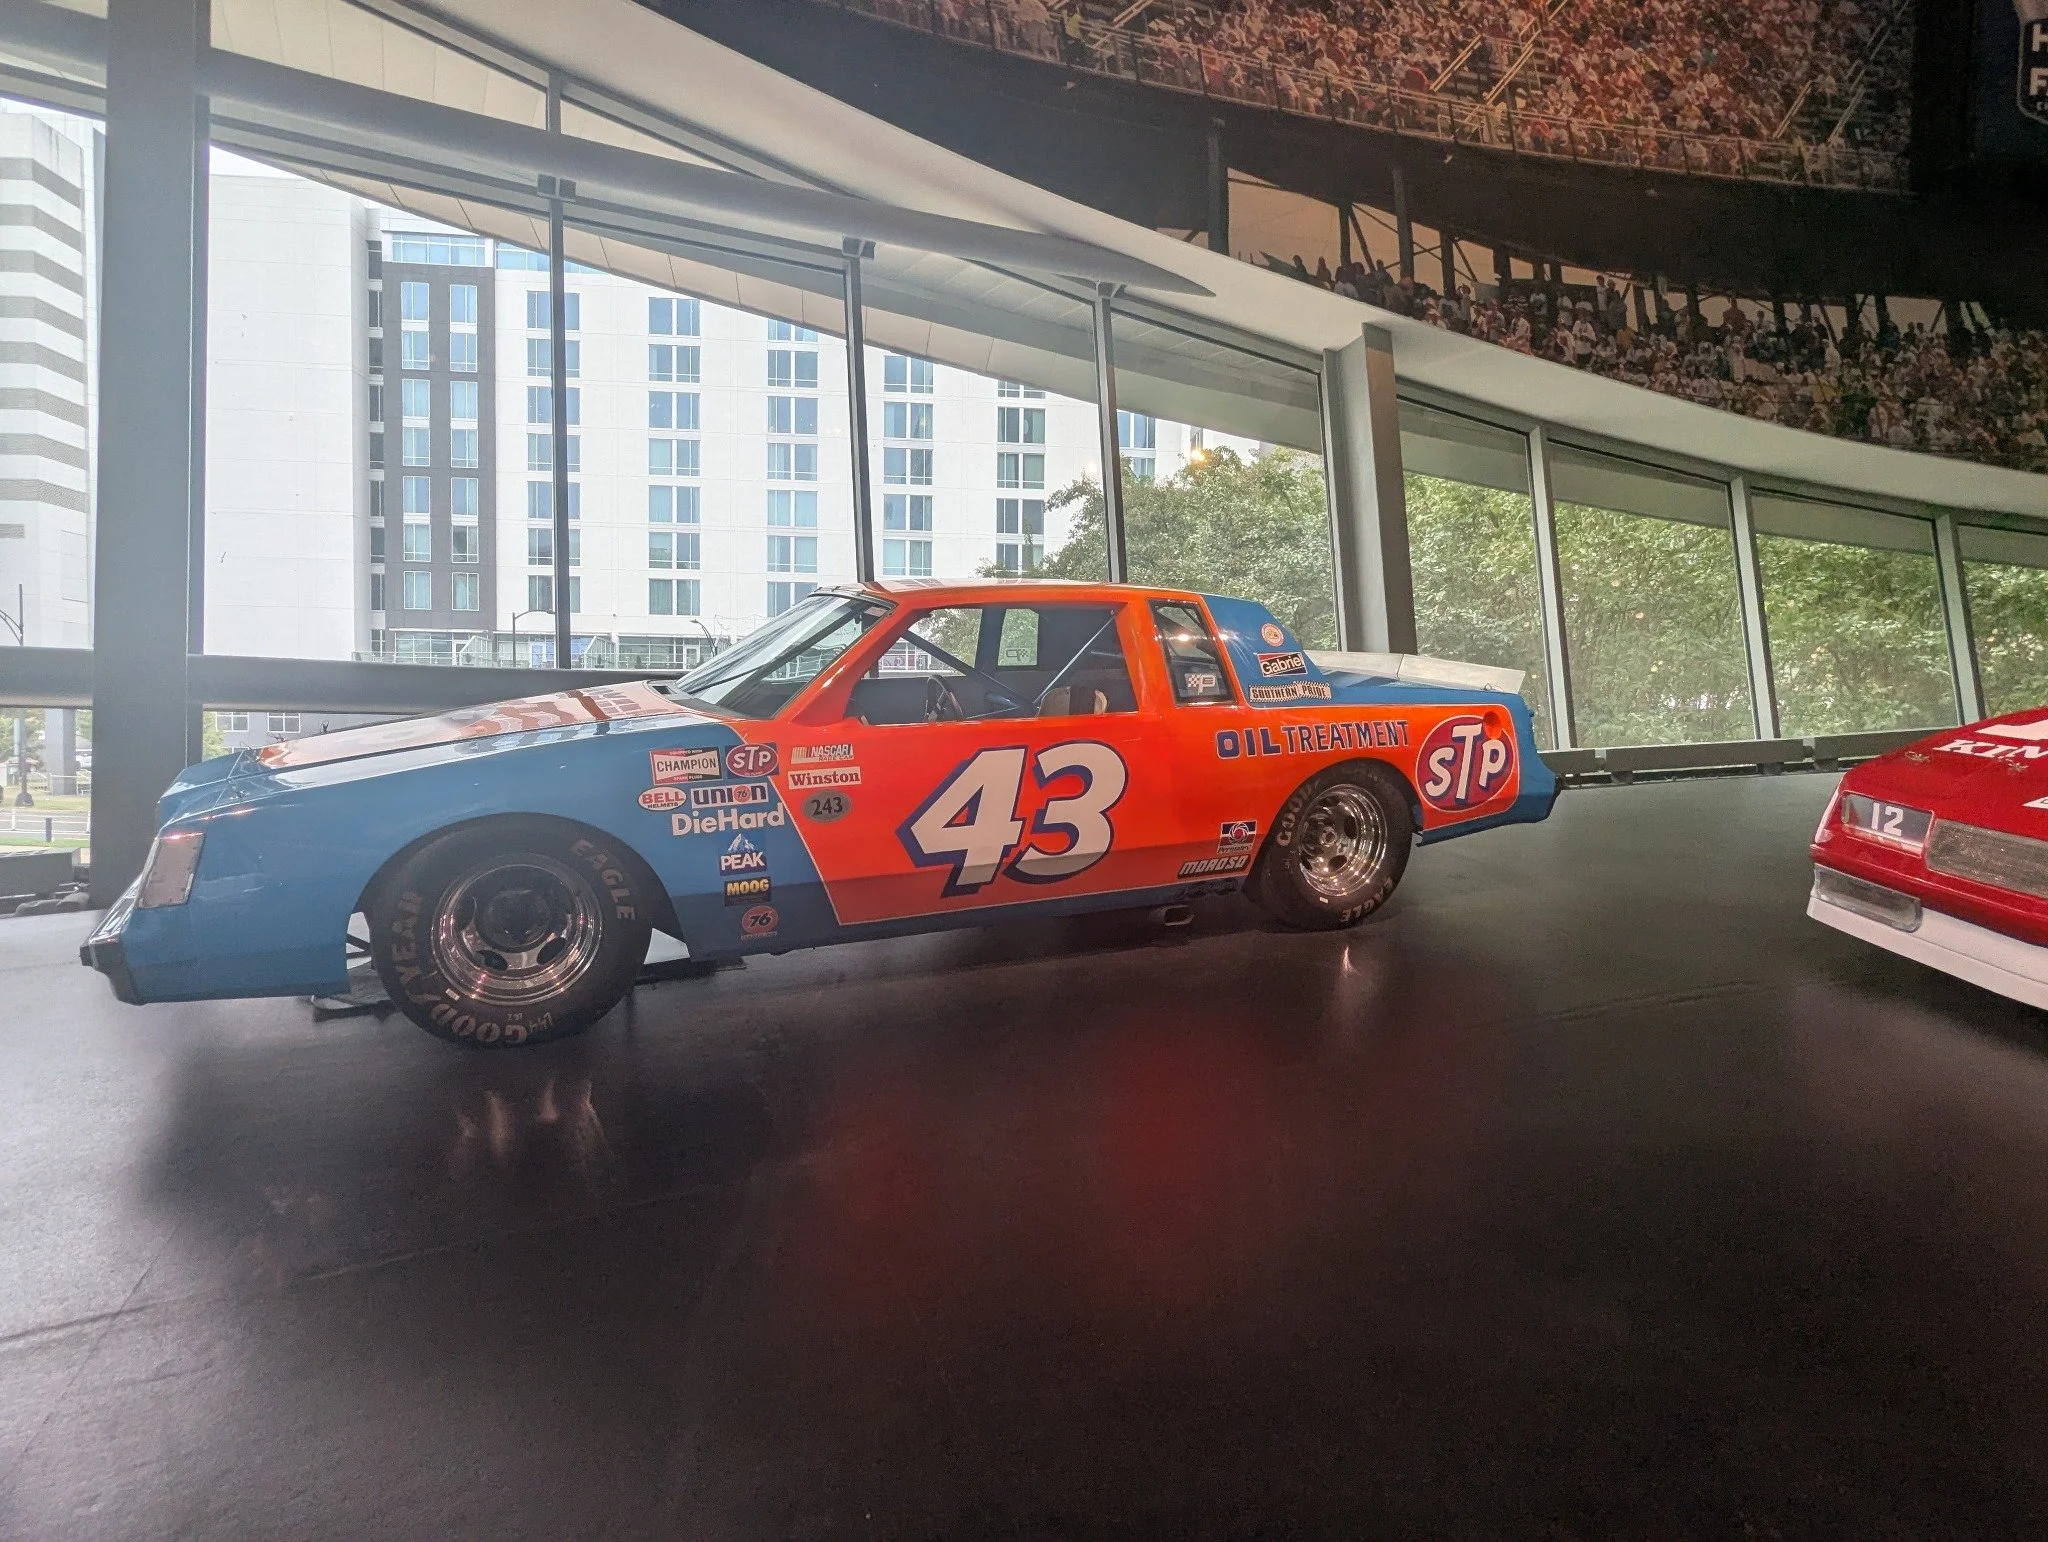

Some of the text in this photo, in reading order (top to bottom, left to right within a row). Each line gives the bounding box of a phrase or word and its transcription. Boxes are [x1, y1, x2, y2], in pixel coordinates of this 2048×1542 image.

[1261, 652, 1304, 675] Gabriel
[1252, 685, 1326, 700] SOUTHERN PRIDE
[1215, 719, 1410, 760] OIL TREATMENT
[733, 746, 771, 770] STP
[811, 744, 850, 758] NASCAR
[657, 757, 717, 772] CHAMPION
[1424, 722, 1508, 806] STP
[790, 771, 860, 787] Winston
[642, 791, 685, 804] BELL
[811, 796, 843, 816] 243
[672, 802, 785, 836] DieHard
[895, 739, 1129, 899] 43
[1870, 802, 1905, 837] 12
[721, 851, 765, 870] PEAK
[1178, 854, 1249, 875] MOROSO
[573, 838, 636, 921] EAGLE
[727, 878, 770, 896] MOOG
[749, 912, 772, 927] 76
